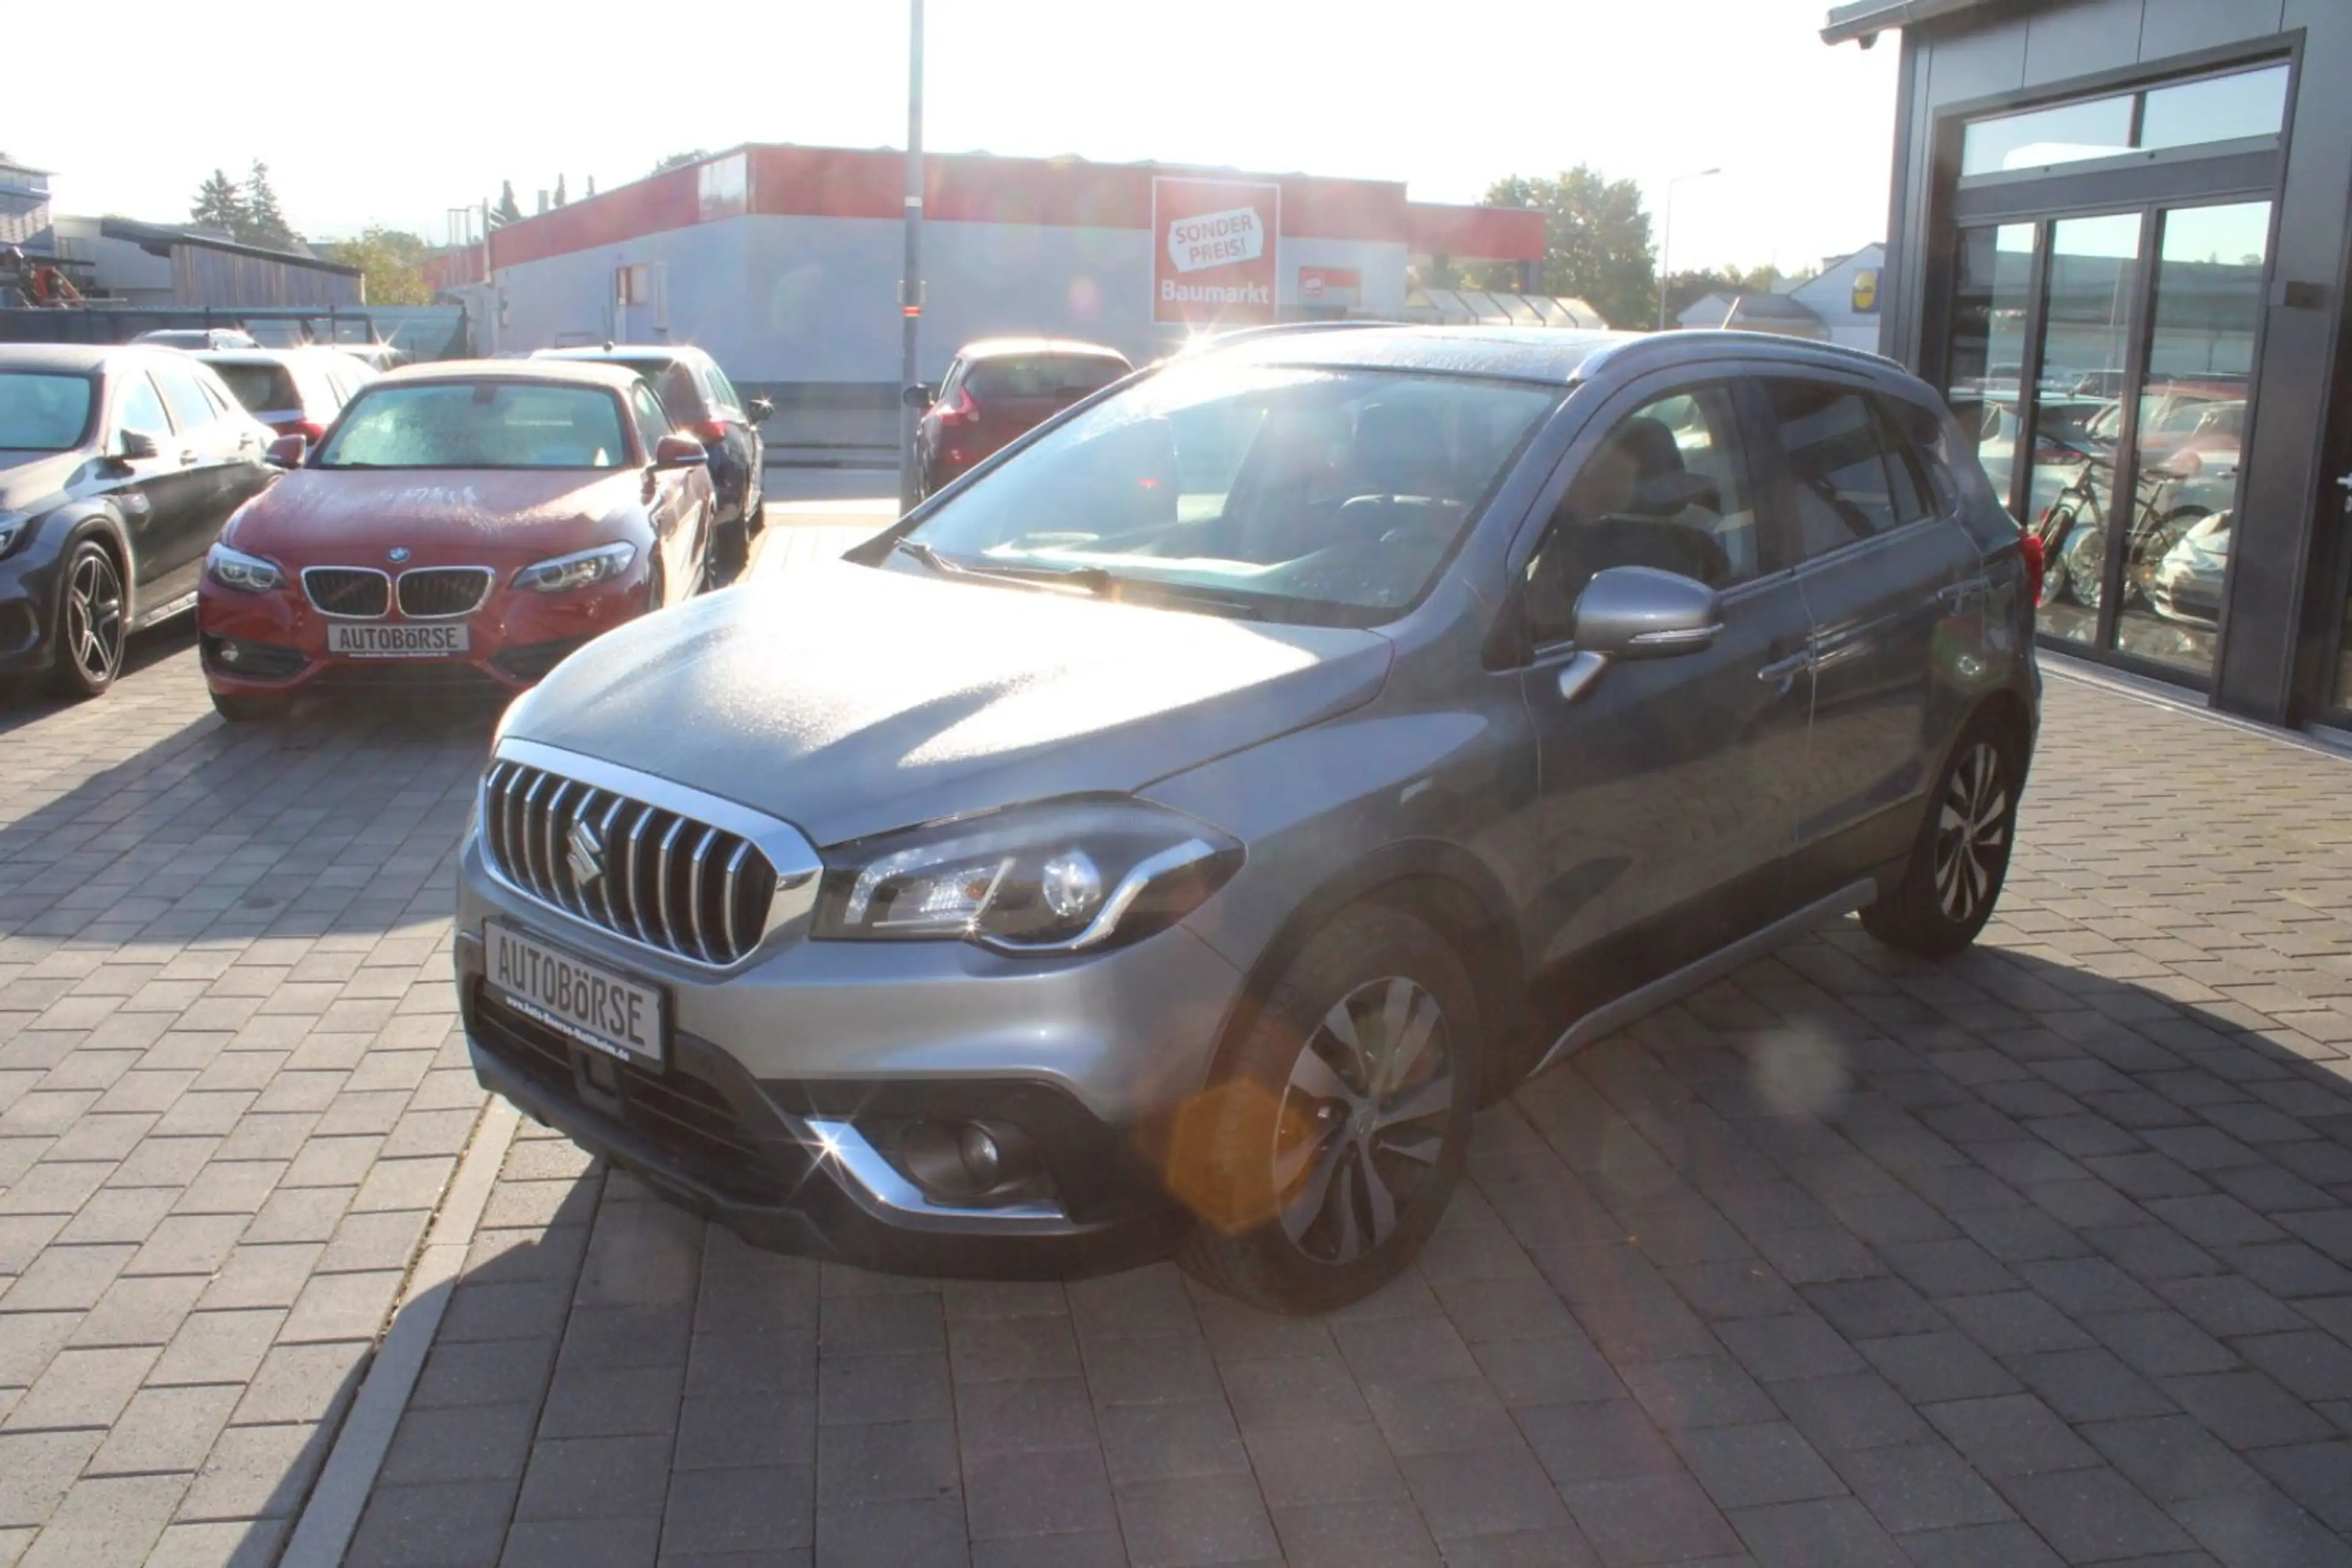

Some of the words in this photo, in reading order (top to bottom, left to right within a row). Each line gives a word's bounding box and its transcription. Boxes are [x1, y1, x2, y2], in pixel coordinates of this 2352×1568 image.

[1175, 214, 1253, 245] SONDER
[1189, 238, 1247, 264] PREIS!
[1162, 279, 1268, 304] Baumarkt
